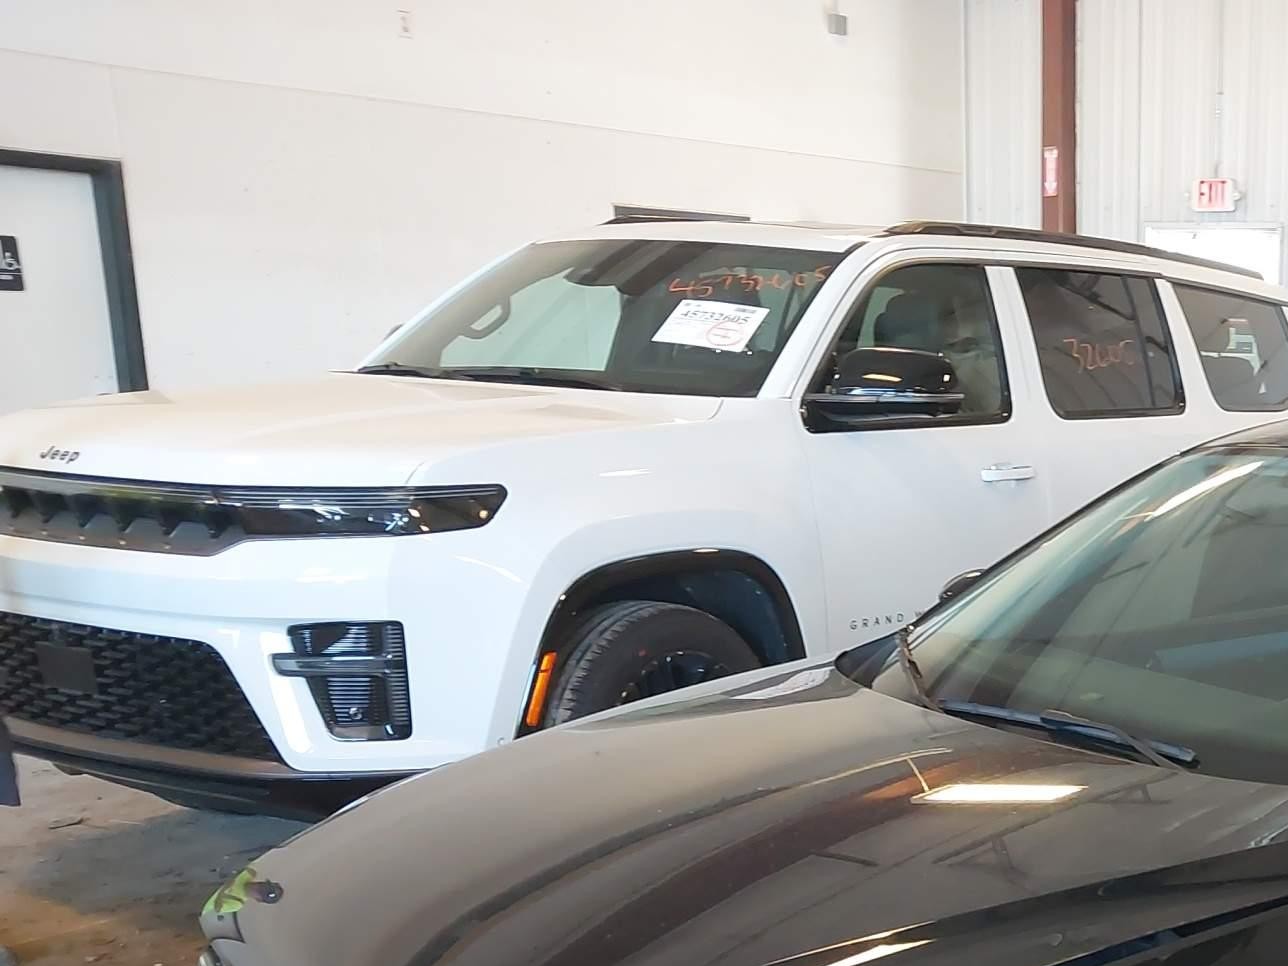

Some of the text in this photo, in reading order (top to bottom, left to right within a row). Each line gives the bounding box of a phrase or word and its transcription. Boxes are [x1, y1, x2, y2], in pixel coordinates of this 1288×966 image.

[680, 310, 751, 325] 45732605
[40, 445, 80, 464] Jeep
[849, 612, 905, 630] GRAND
